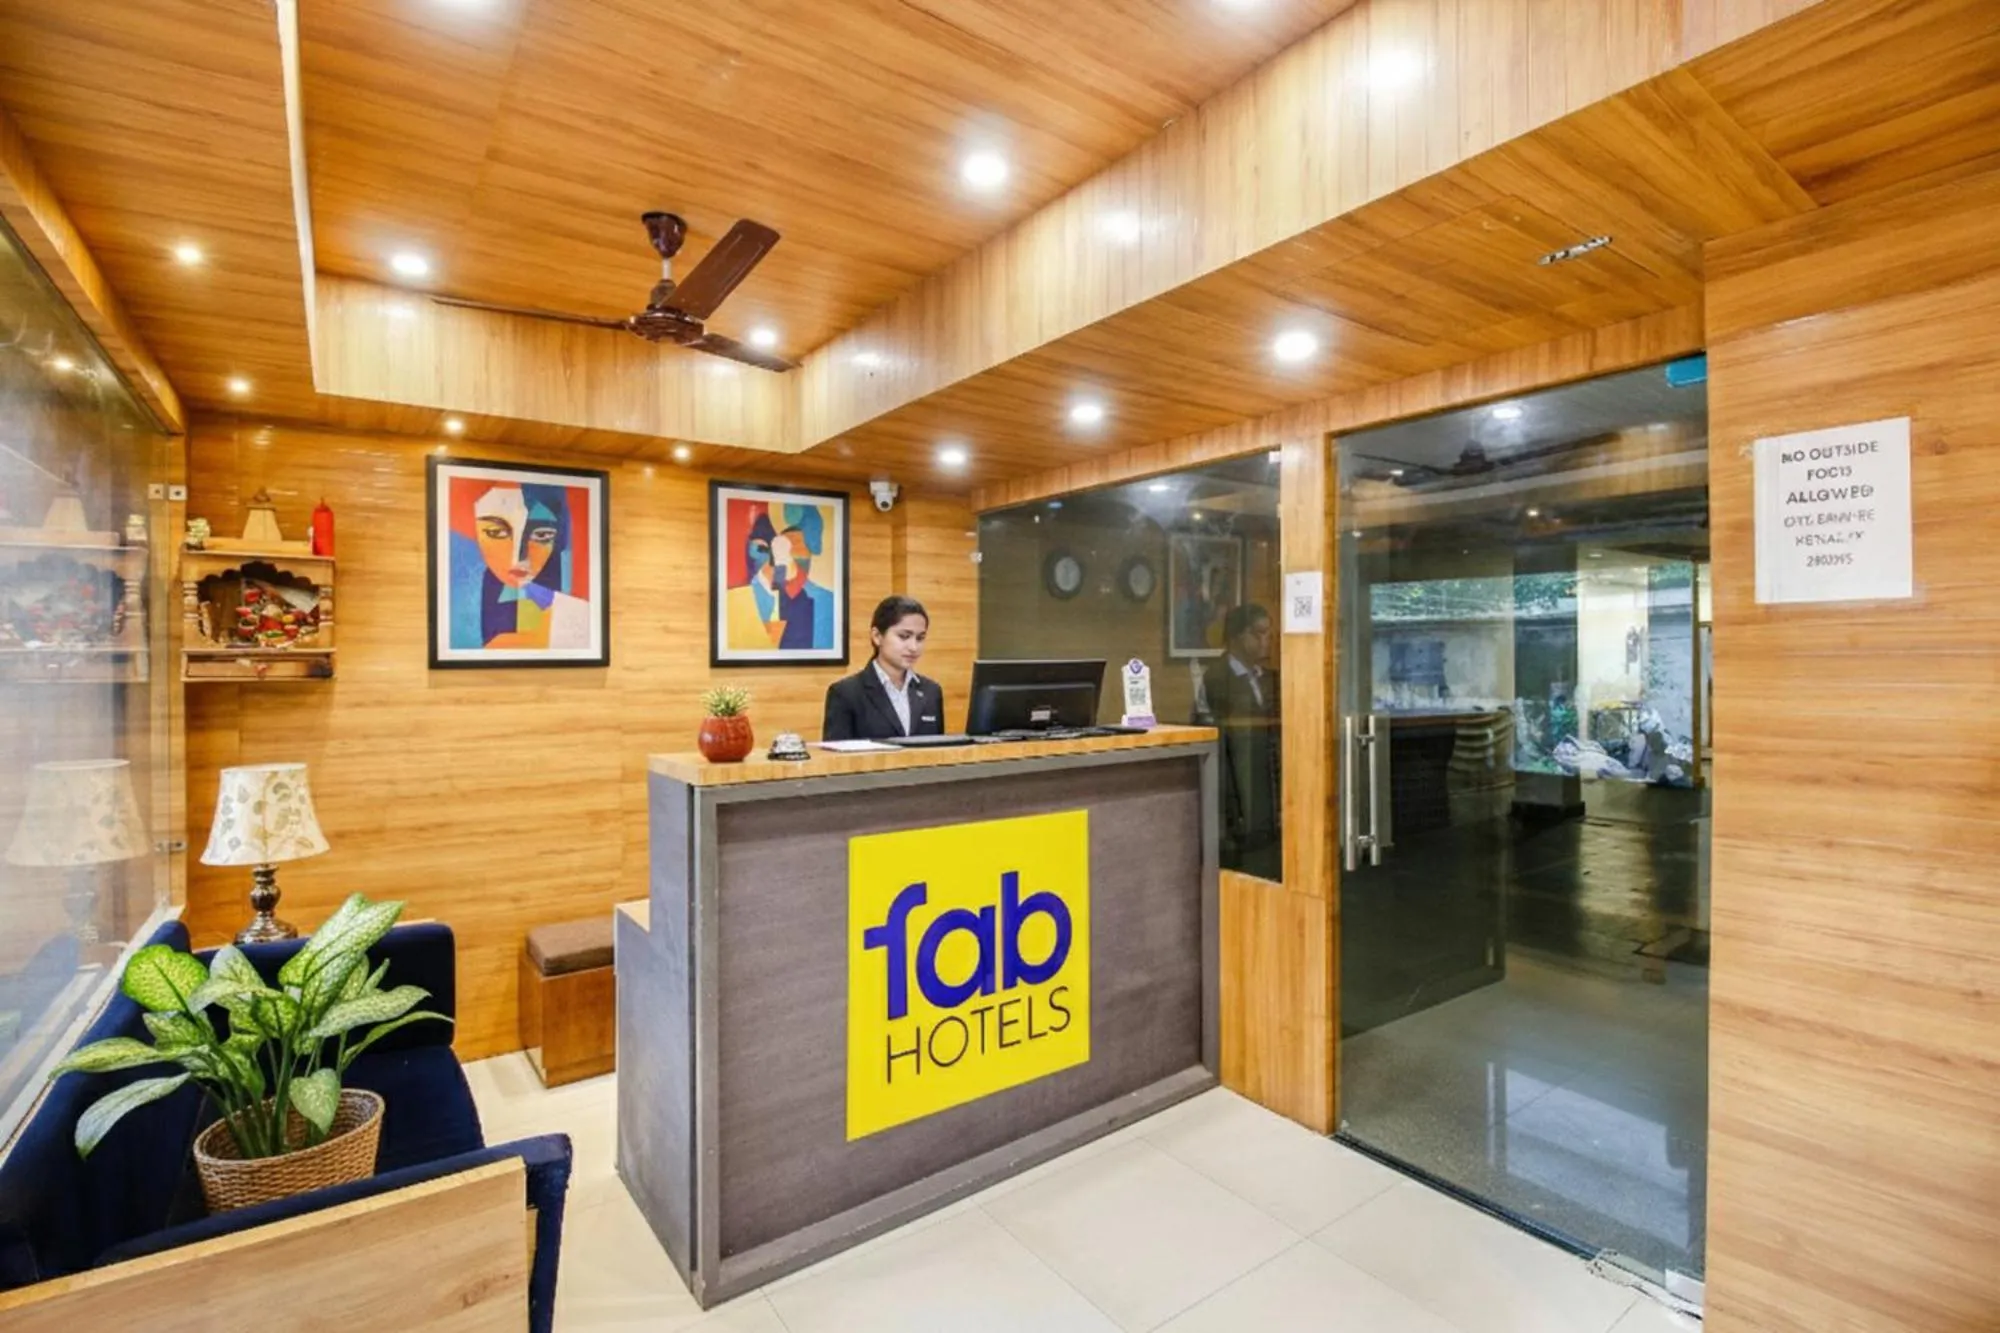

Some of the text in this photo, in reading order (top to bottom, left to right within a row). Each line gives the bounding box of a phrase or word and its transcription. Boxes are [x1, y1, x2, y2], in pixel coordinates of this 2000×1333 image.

[1781, 440, 1878, 464] NO OUTSIDE
[863, 871, 1073, 1021] fab
[887, 986, 1071, 1084] HOTELS
